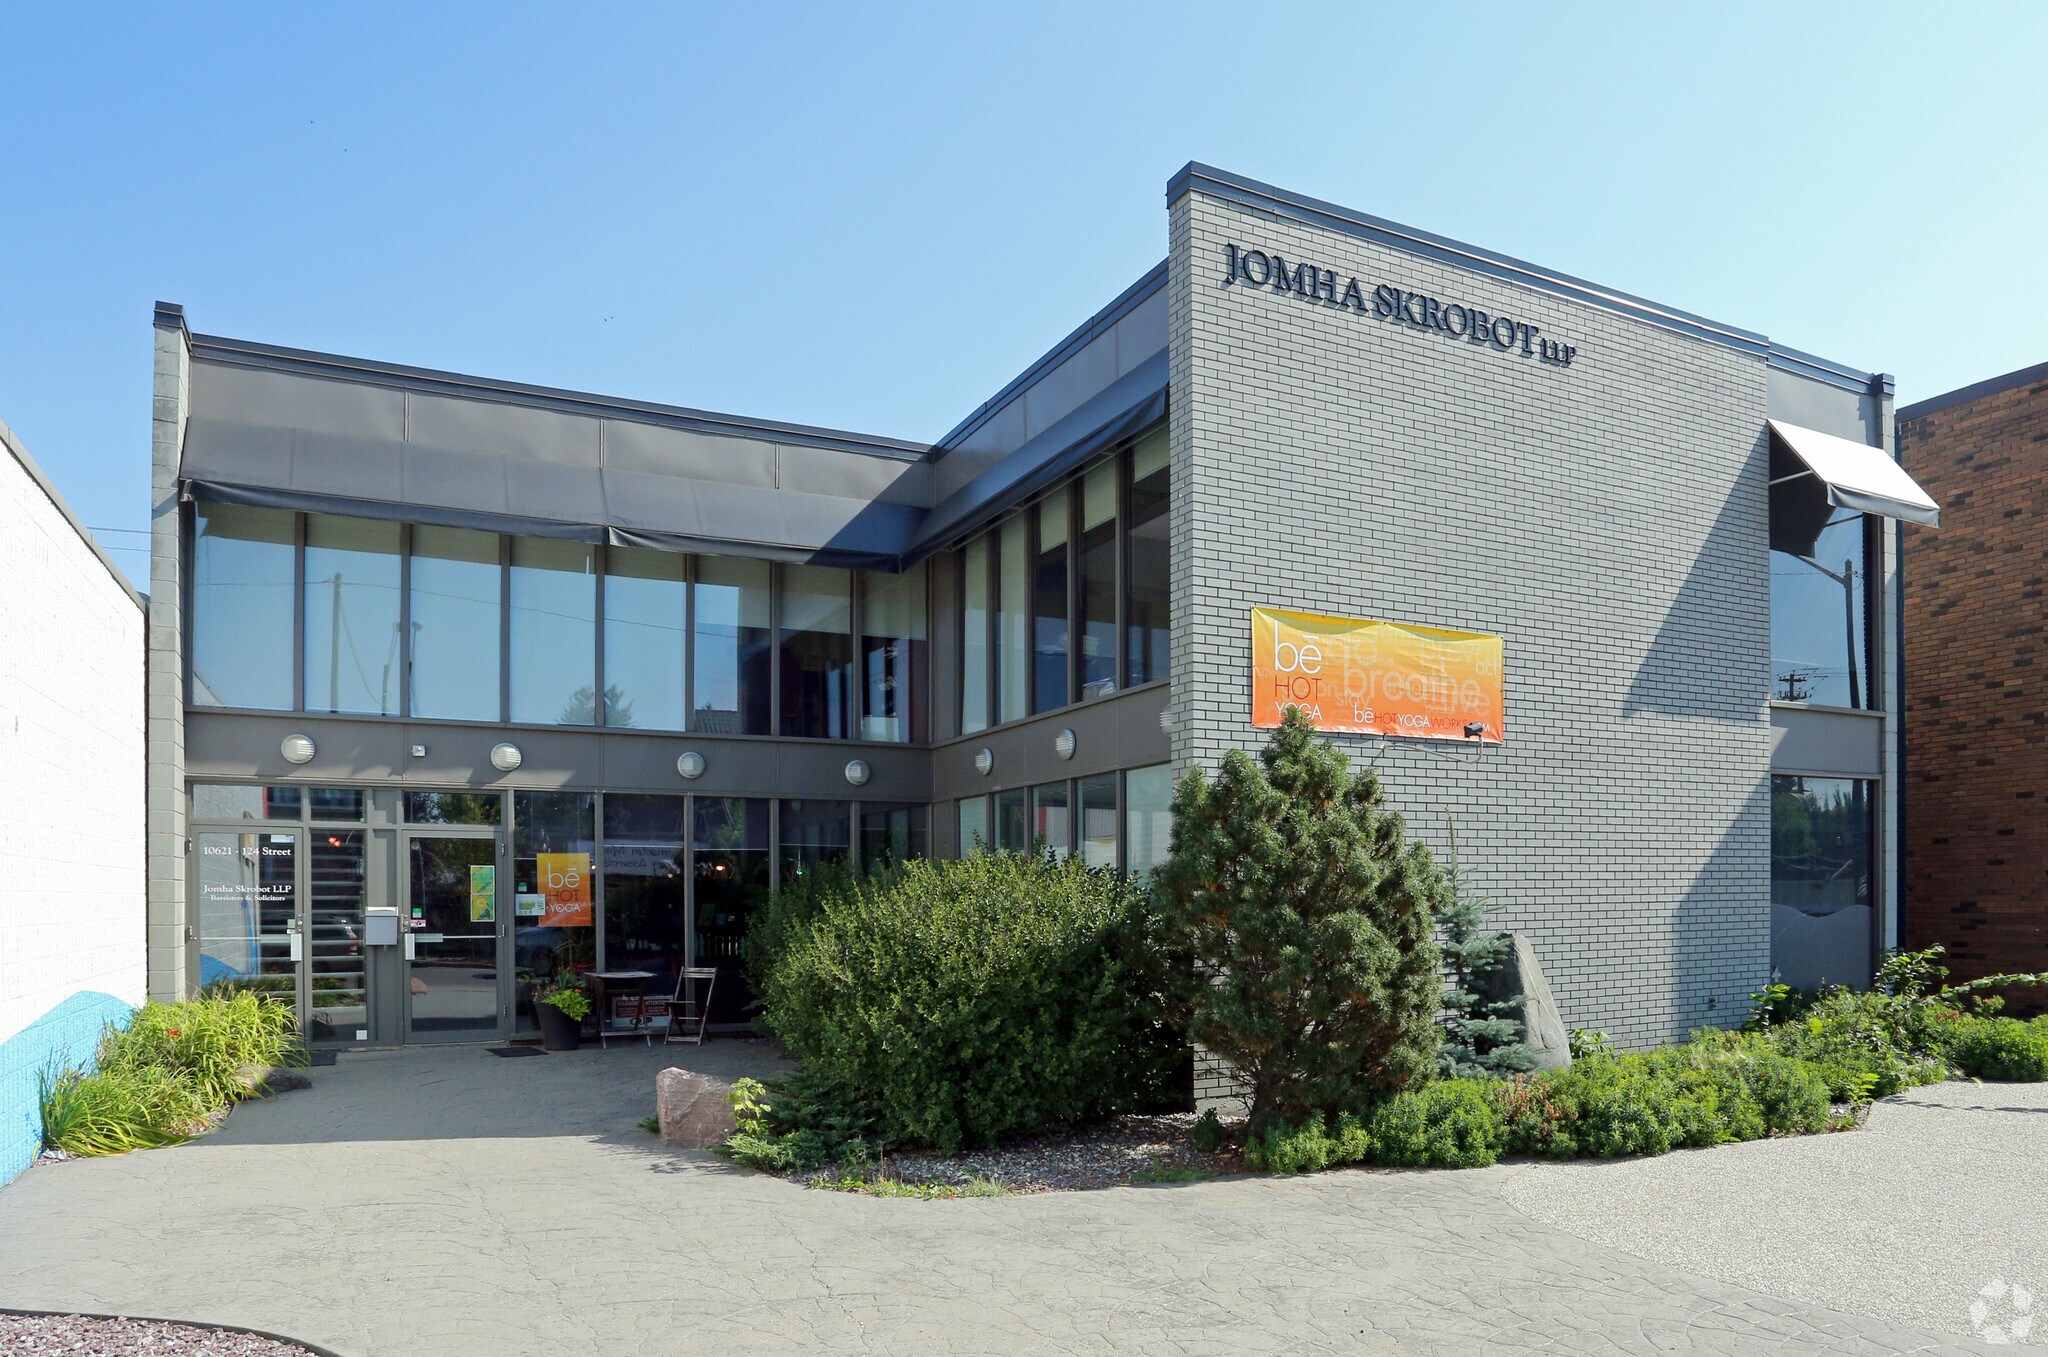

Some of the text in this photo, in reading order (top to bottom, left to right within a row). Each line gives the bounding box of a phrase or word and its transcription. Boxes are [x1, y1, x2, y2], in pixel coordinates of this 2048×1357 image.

[1226, 242, 1578, 367] JOMHA SKROBOT LLP
[1274, 675, 1323, 701] HOT
[203, 846, 232, 855] 10621
[242, 846, 260, 855] 124
[262, 846, 291, 856] Street
[203, 884, 292, 894] Jomha Skrobot LLP
[548, 889, 580, 902] HOT
[550, 903, 581, 913] YOGA
